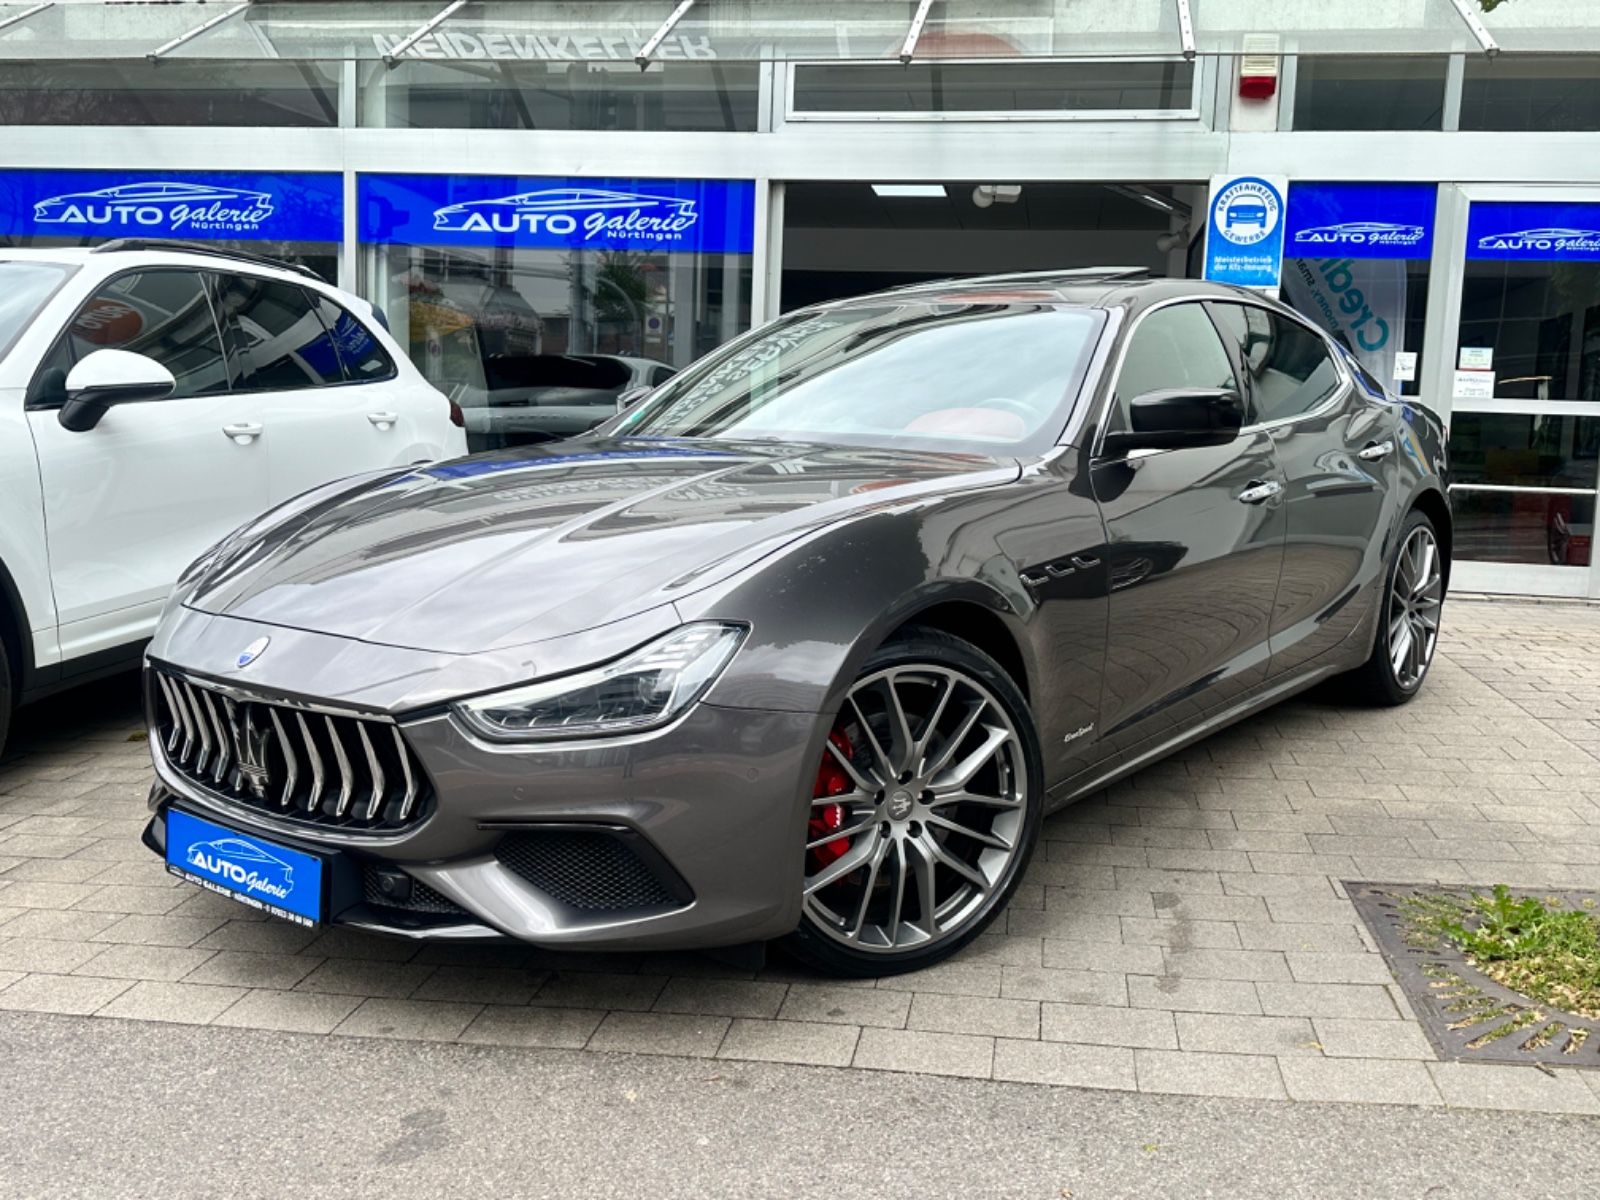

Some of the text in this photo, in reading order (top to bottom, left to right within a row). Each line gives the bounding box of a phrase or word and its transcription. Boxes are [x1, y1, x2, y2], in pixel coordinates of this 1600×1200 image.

[1218, 183, 1277, 212] KRAFTFAHRZEUG
[60, 201, 264, 230] AUTO galerie
[191, 221, 259, 231] Nürtingen
[461, 209, 686, 240] AUTO galerie
[607, 230, 682, 241] Nürtingen
[1223, 229, 1266, 244] GEWERBE
[1309, 232, 1366, 243] AUTO
[1493, 239, 1552, 250] AUTO
[194, 851, 287, 899] AUTO Galerie
